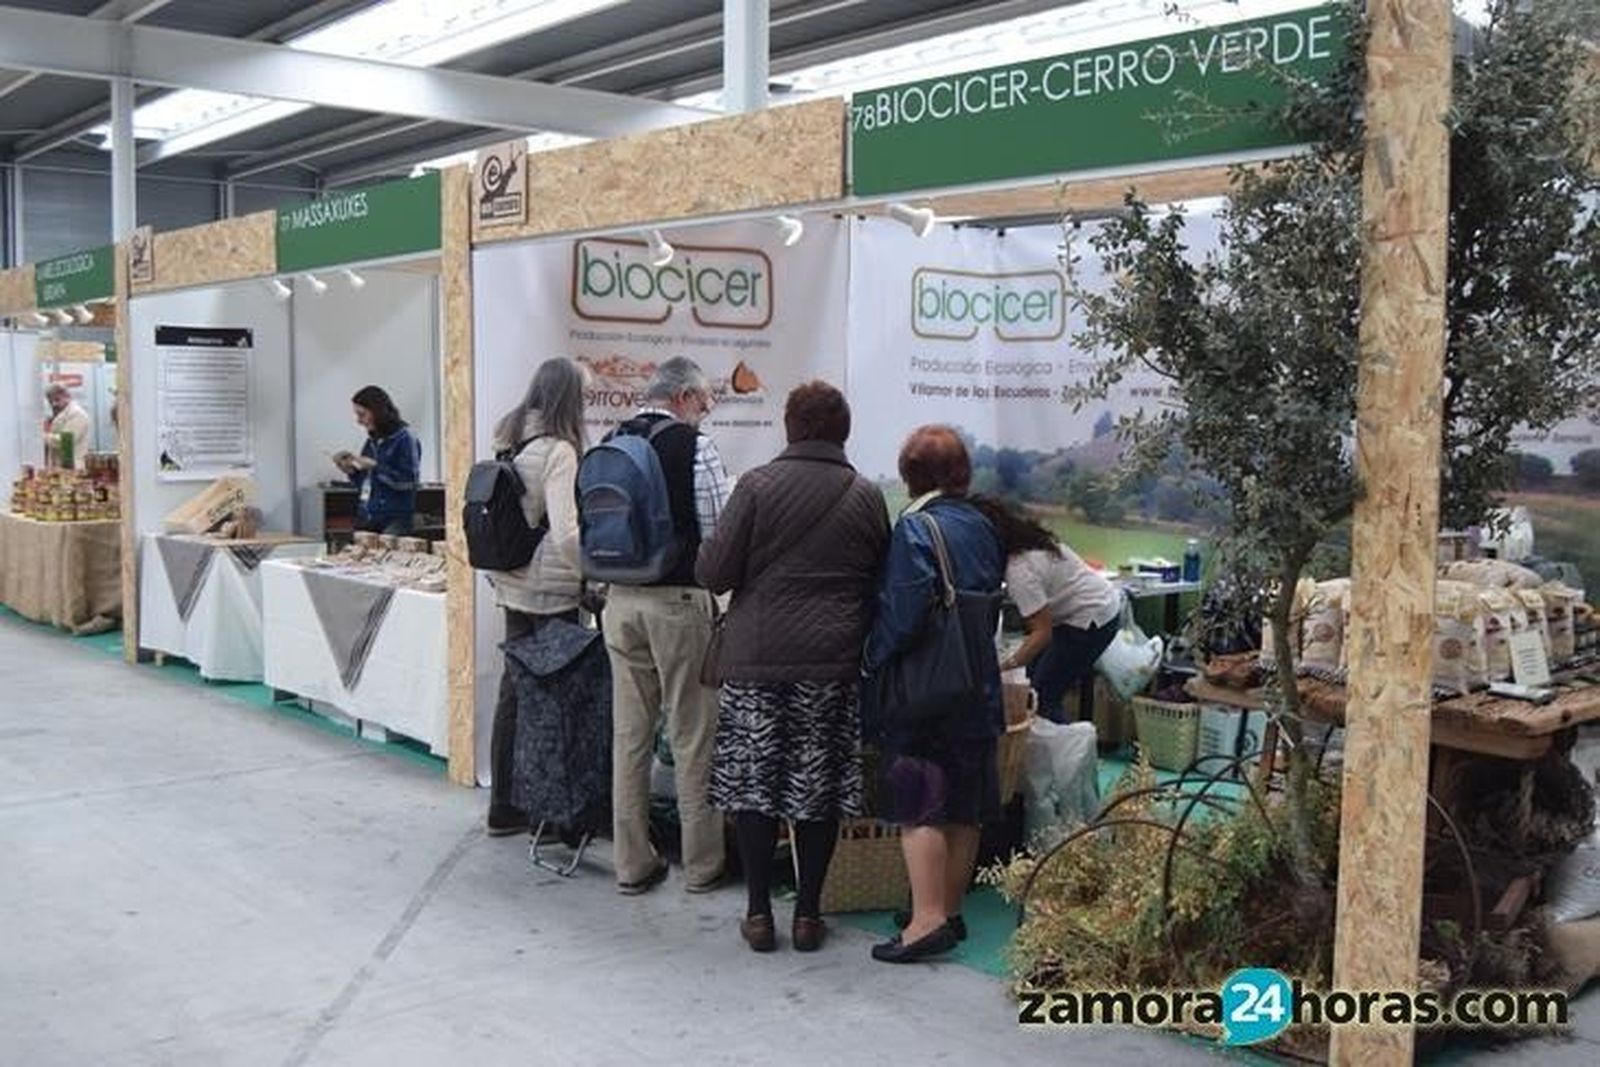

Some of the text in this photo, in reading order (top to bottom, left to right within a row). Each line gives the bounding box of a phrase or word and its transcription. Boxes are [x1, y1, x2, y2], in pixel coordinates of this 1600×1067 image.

[1188, 14, 1332, 76] VERDE
[581, 246, 762, 307] biocicer
[918, 277, 1058, 324] biocicer
